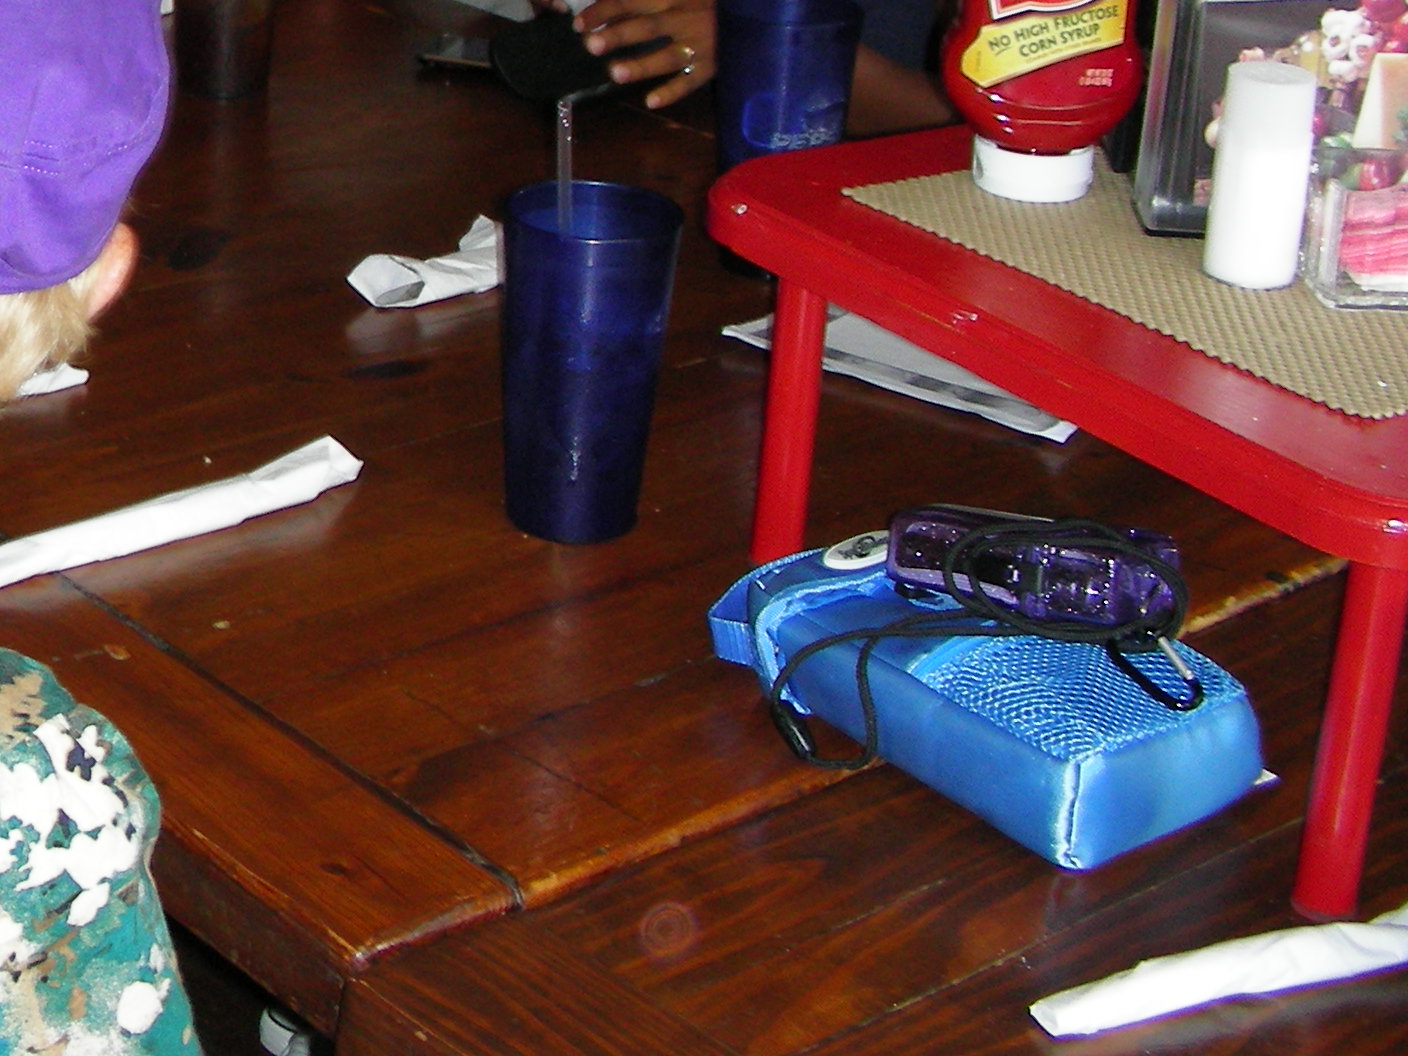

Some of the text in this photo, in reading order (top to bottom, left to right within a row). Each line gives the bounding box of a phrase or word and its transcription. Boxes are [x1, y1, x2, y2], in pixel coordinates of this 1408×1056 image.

[987, 34, 1012, 52] NO
[1013, 23, 1050, 43] HIGH
[1053, 5, 1120, 31] FRUCTOSE
[1018, 37, 1058, 58] CORN
[1059, 23, 1101, 45] SYRUP
